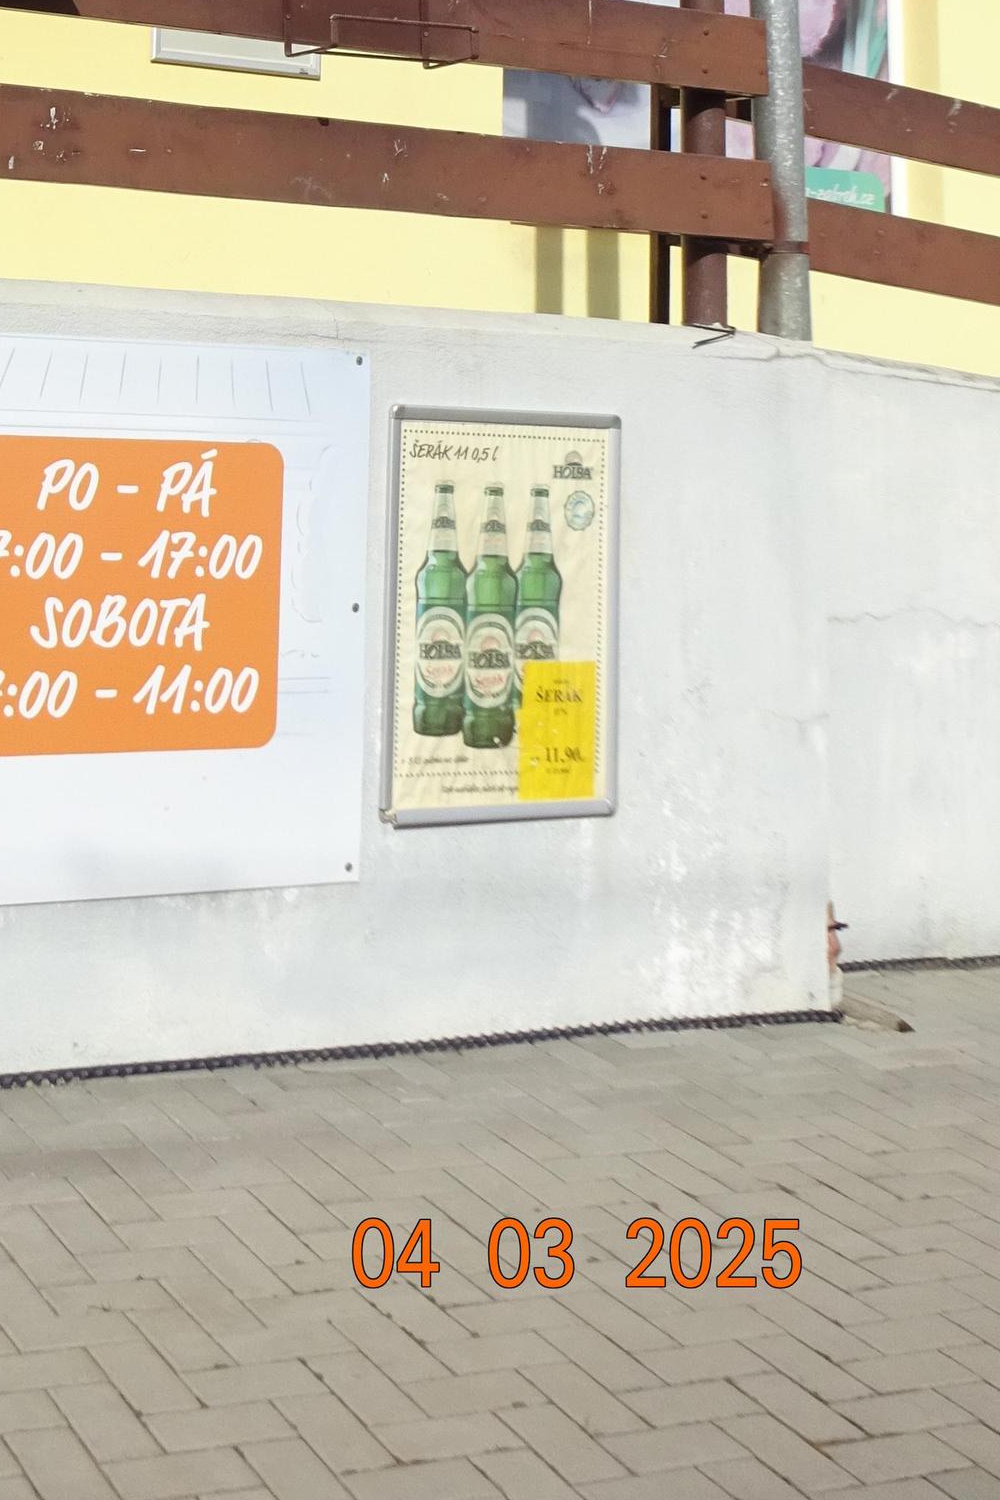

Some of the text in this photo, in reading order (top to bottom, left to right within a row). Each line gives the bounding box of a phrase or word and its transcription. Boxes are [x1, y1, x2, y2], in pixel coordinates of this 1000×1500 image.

[409, 440, 454, 461] ŠERÁK
[471, 447, 491, 463] 0,5
[552, 465, 593, 480] HOLBA
[36, 458, 99, 511] PO
[155, 448, 218, 517] PÁ
[137, 529, 263, 580] 17:00
[29, 593, 210, 651] SOBOTA
[132, 664, 260, 714] 11:00
